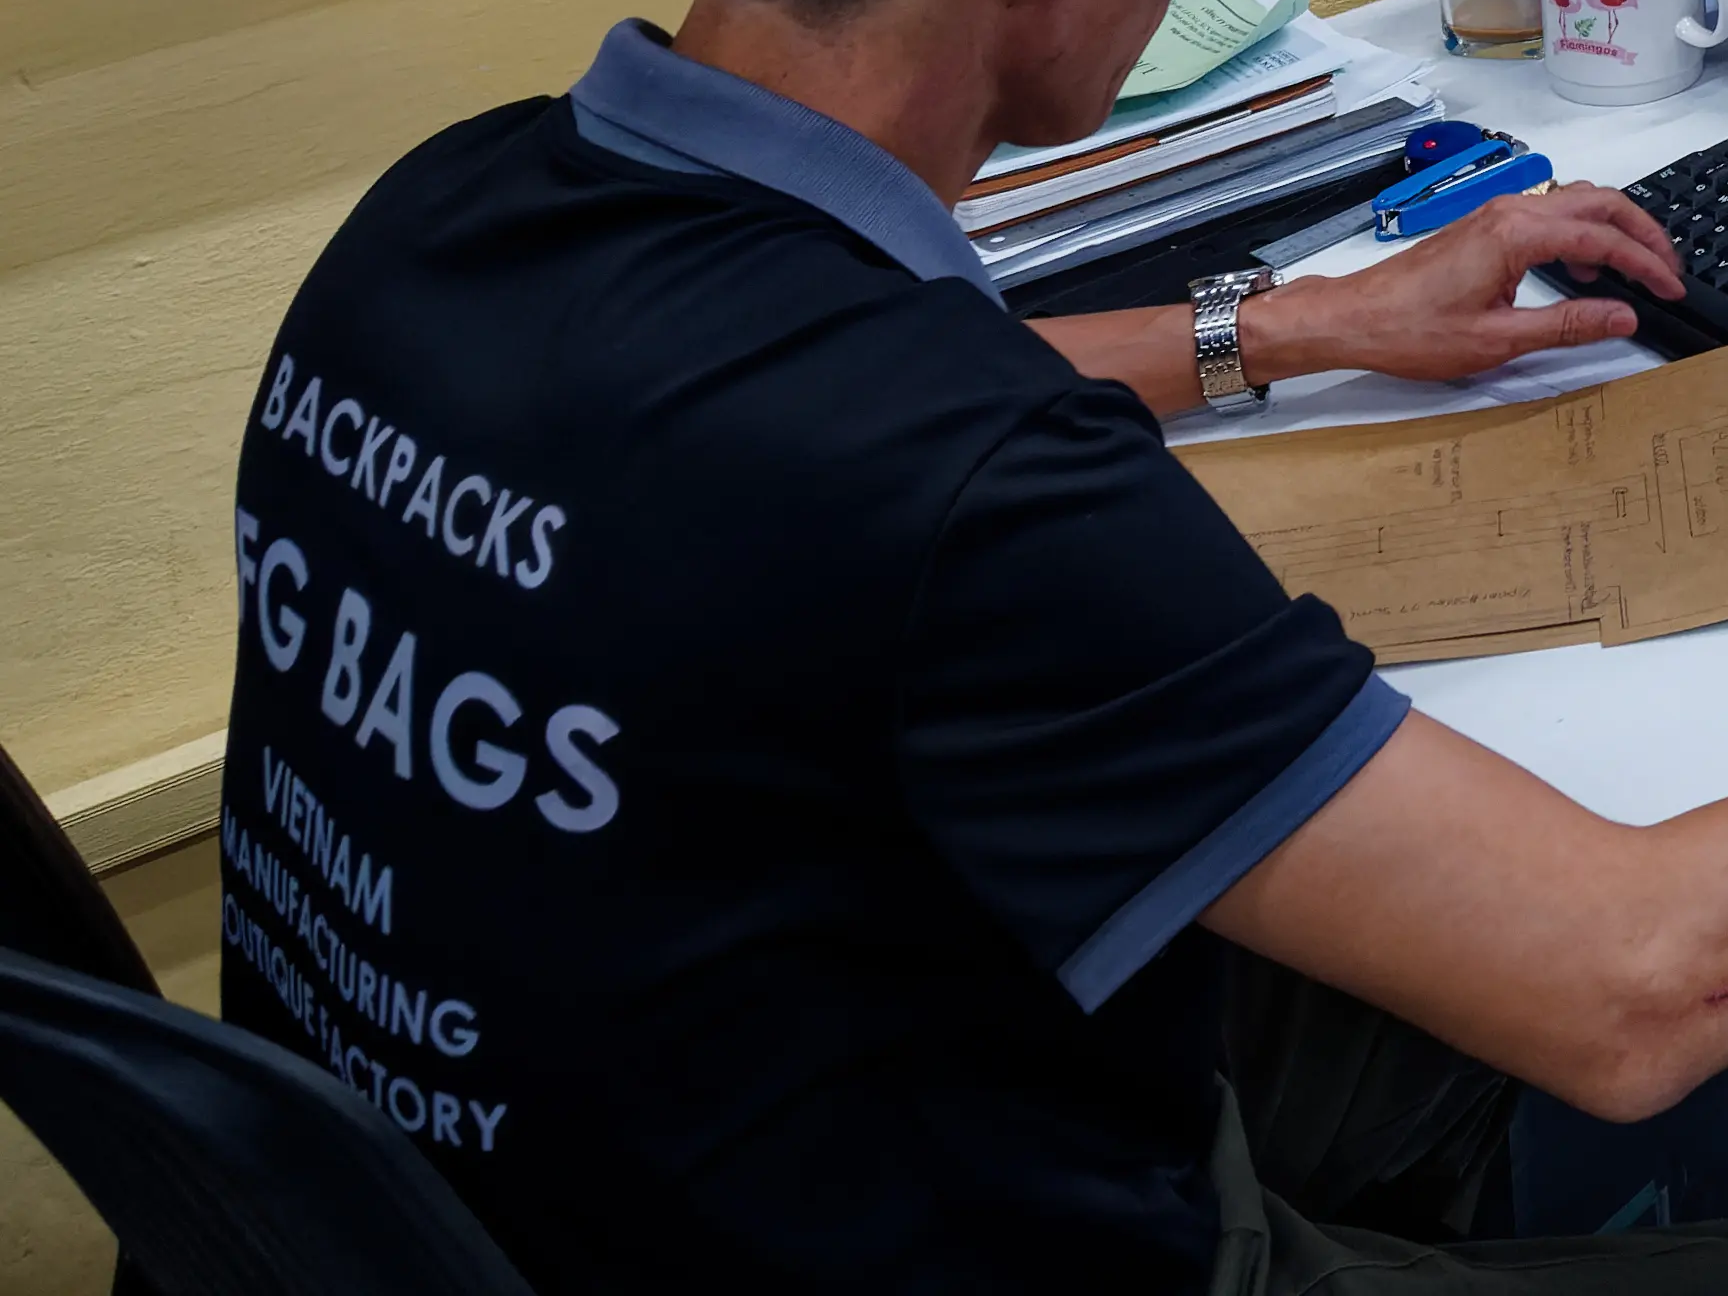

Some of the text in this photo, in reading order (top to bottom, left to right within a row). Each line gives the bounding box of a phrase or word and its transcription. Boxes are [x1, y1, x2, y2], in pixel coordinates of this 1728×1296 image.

[1560, 39, 1618, 57] Flamingos
[260, 352, 568, 589] BACKPACKS
[319, 586, 625, 834] BAGS
[222, 804, 482, 1058] MANUFACTURING
[262, 745, 395, 936] VIETNAM
